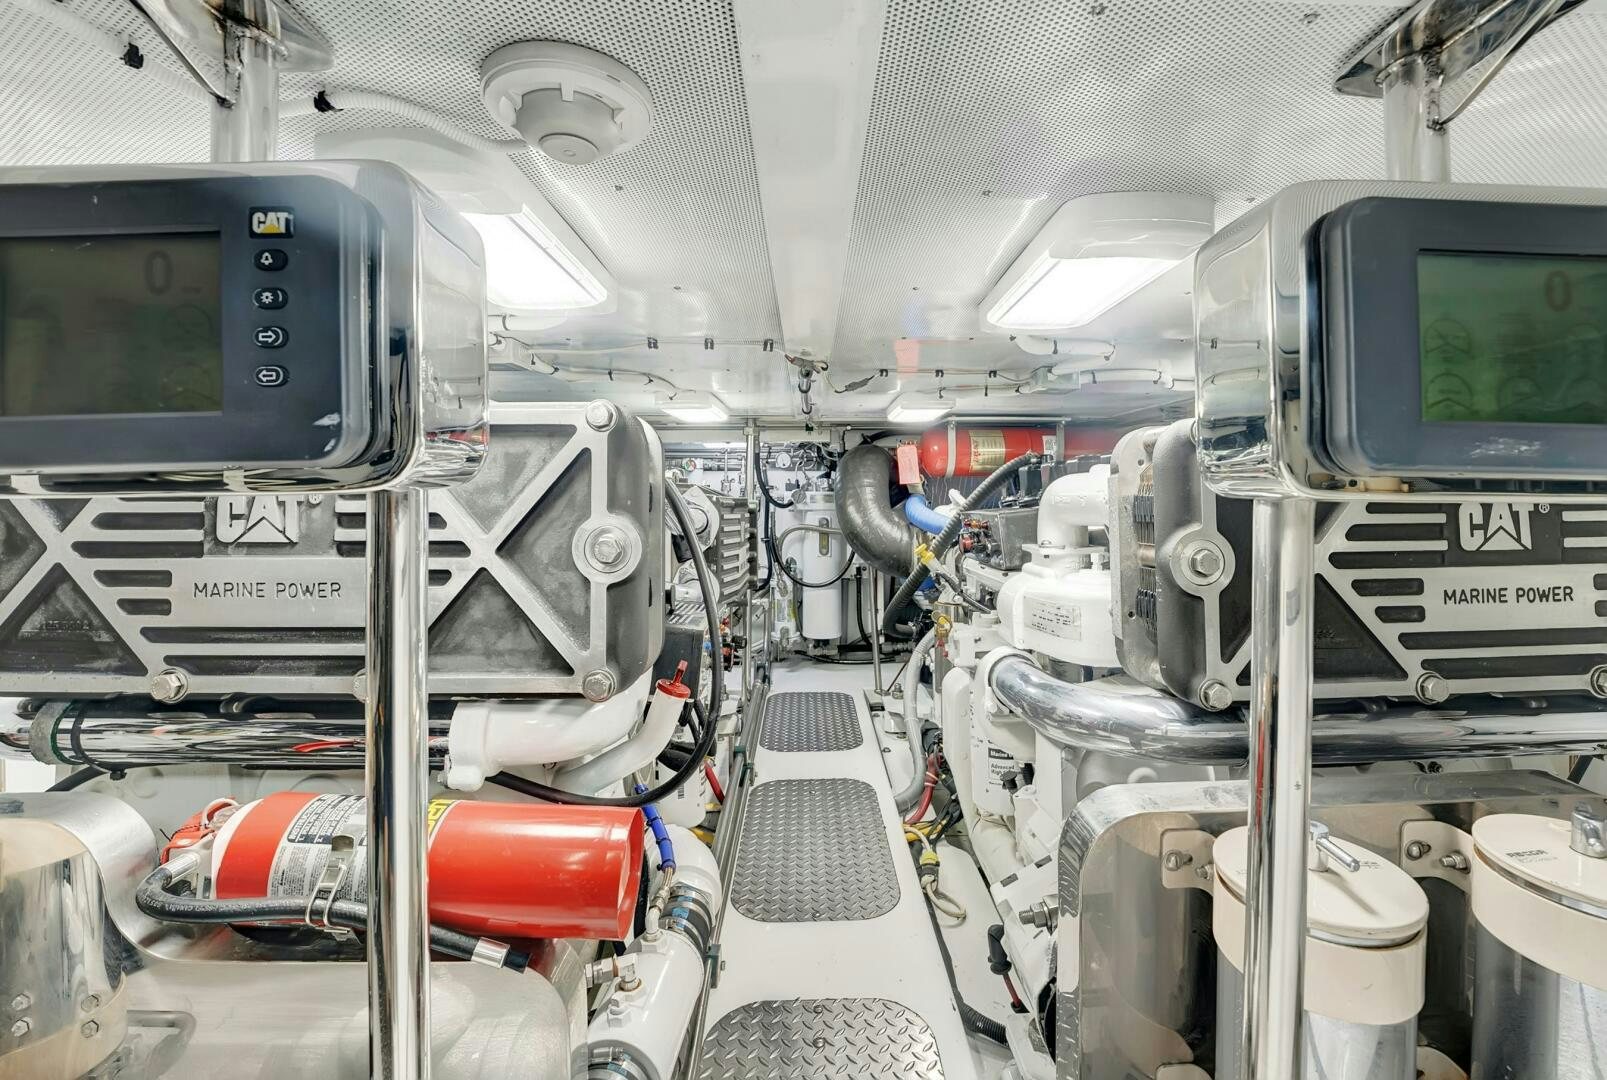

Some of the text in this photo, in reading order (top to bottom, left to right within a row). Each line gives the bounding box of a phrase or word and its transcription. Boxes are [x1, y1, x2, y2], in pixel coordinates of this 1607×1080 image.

[252, 212, 290, 234] CAT
[145, 250, 174, 295] 0
[1545, 270, 1573, 313] 0
[193, 582, 342, 599] MARINE POWER
[1443, 585, 1574, 605] MARINE POWER
